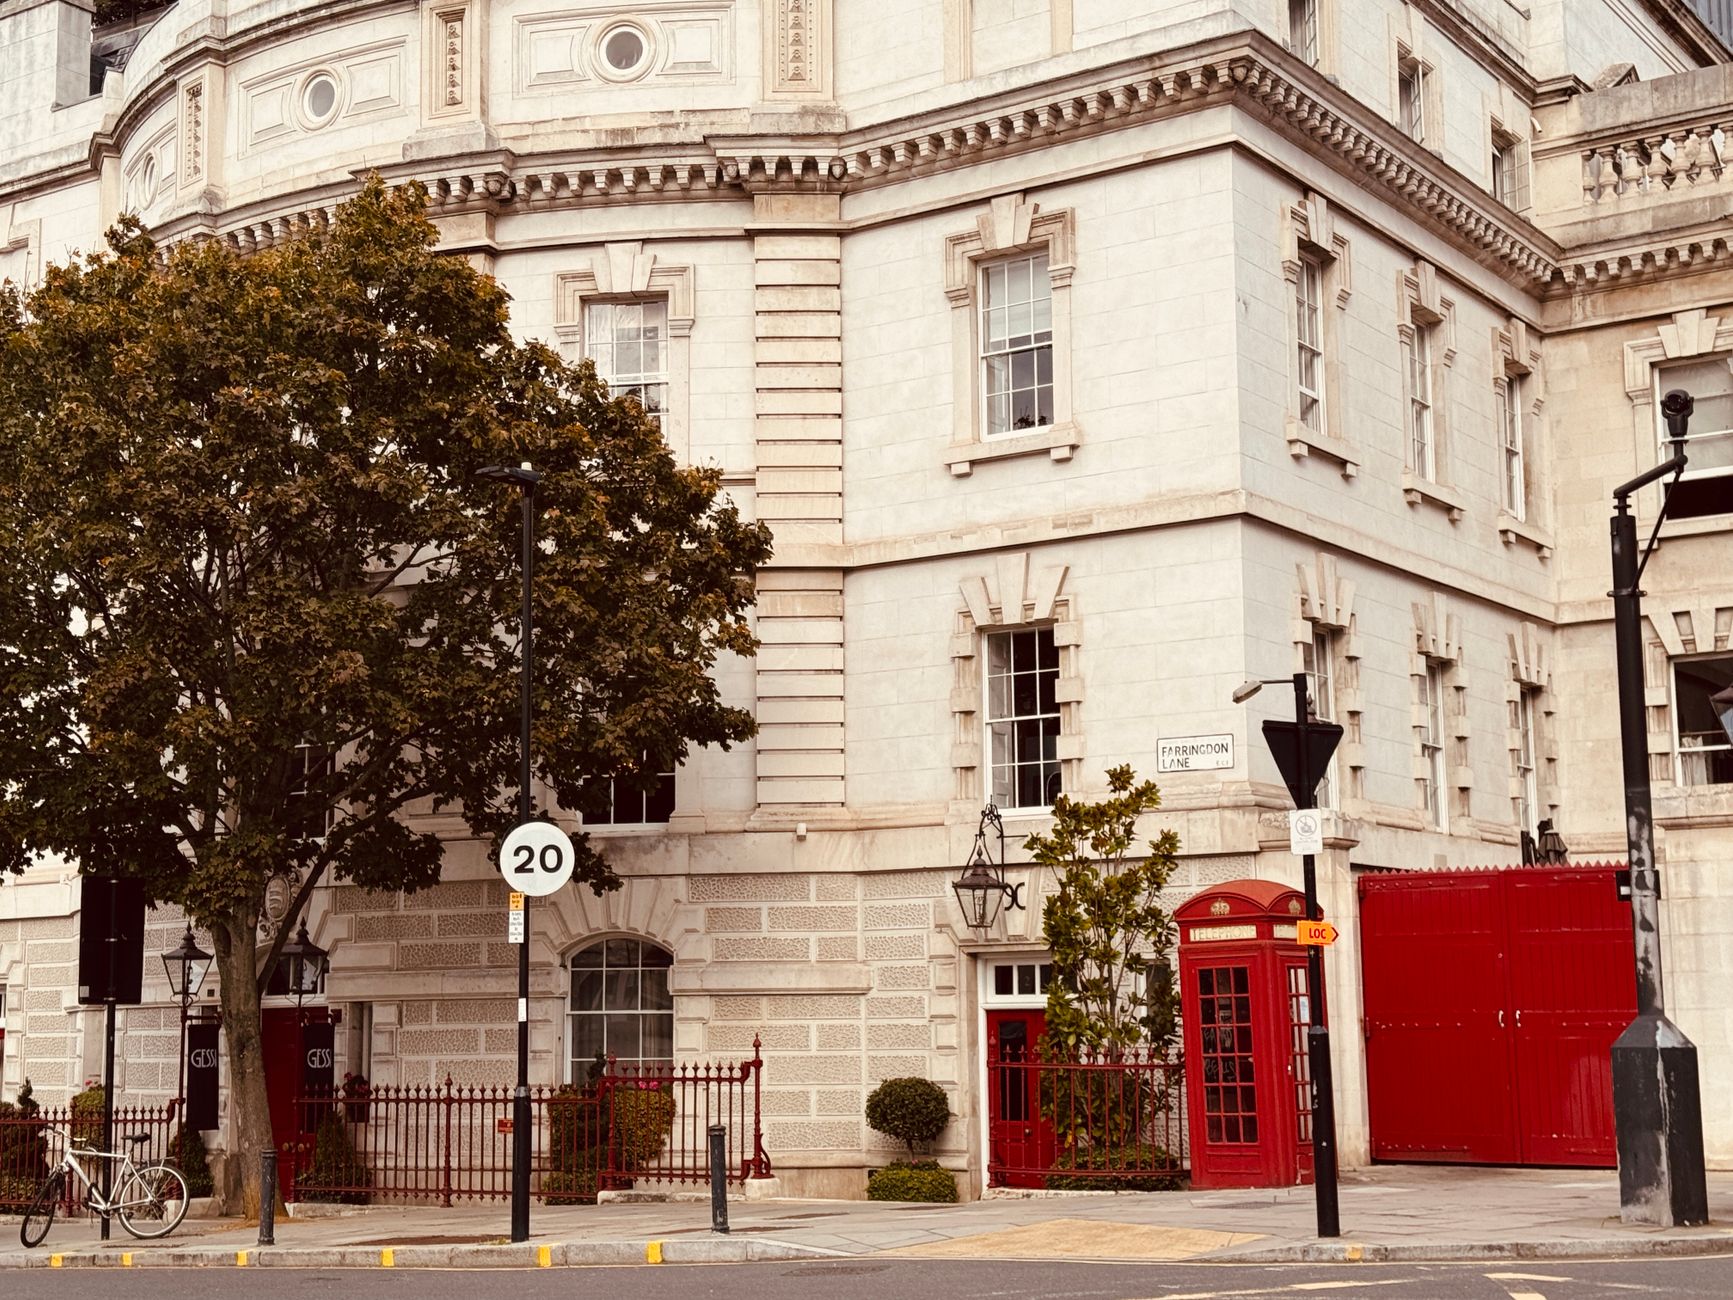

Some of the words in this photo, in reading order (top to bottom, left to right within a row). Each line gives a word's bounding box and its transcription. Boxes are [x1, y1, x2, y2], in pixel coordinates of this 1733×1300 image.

[1161, 742, 1229, 758] FARRINGDON
[1162, 757, 1191, 770] LANE
[513, 844, 563, 874] 20
[1191, 925, 1256, 940] TELEPHONE
[1308, 927, 1327, 940] LOC
